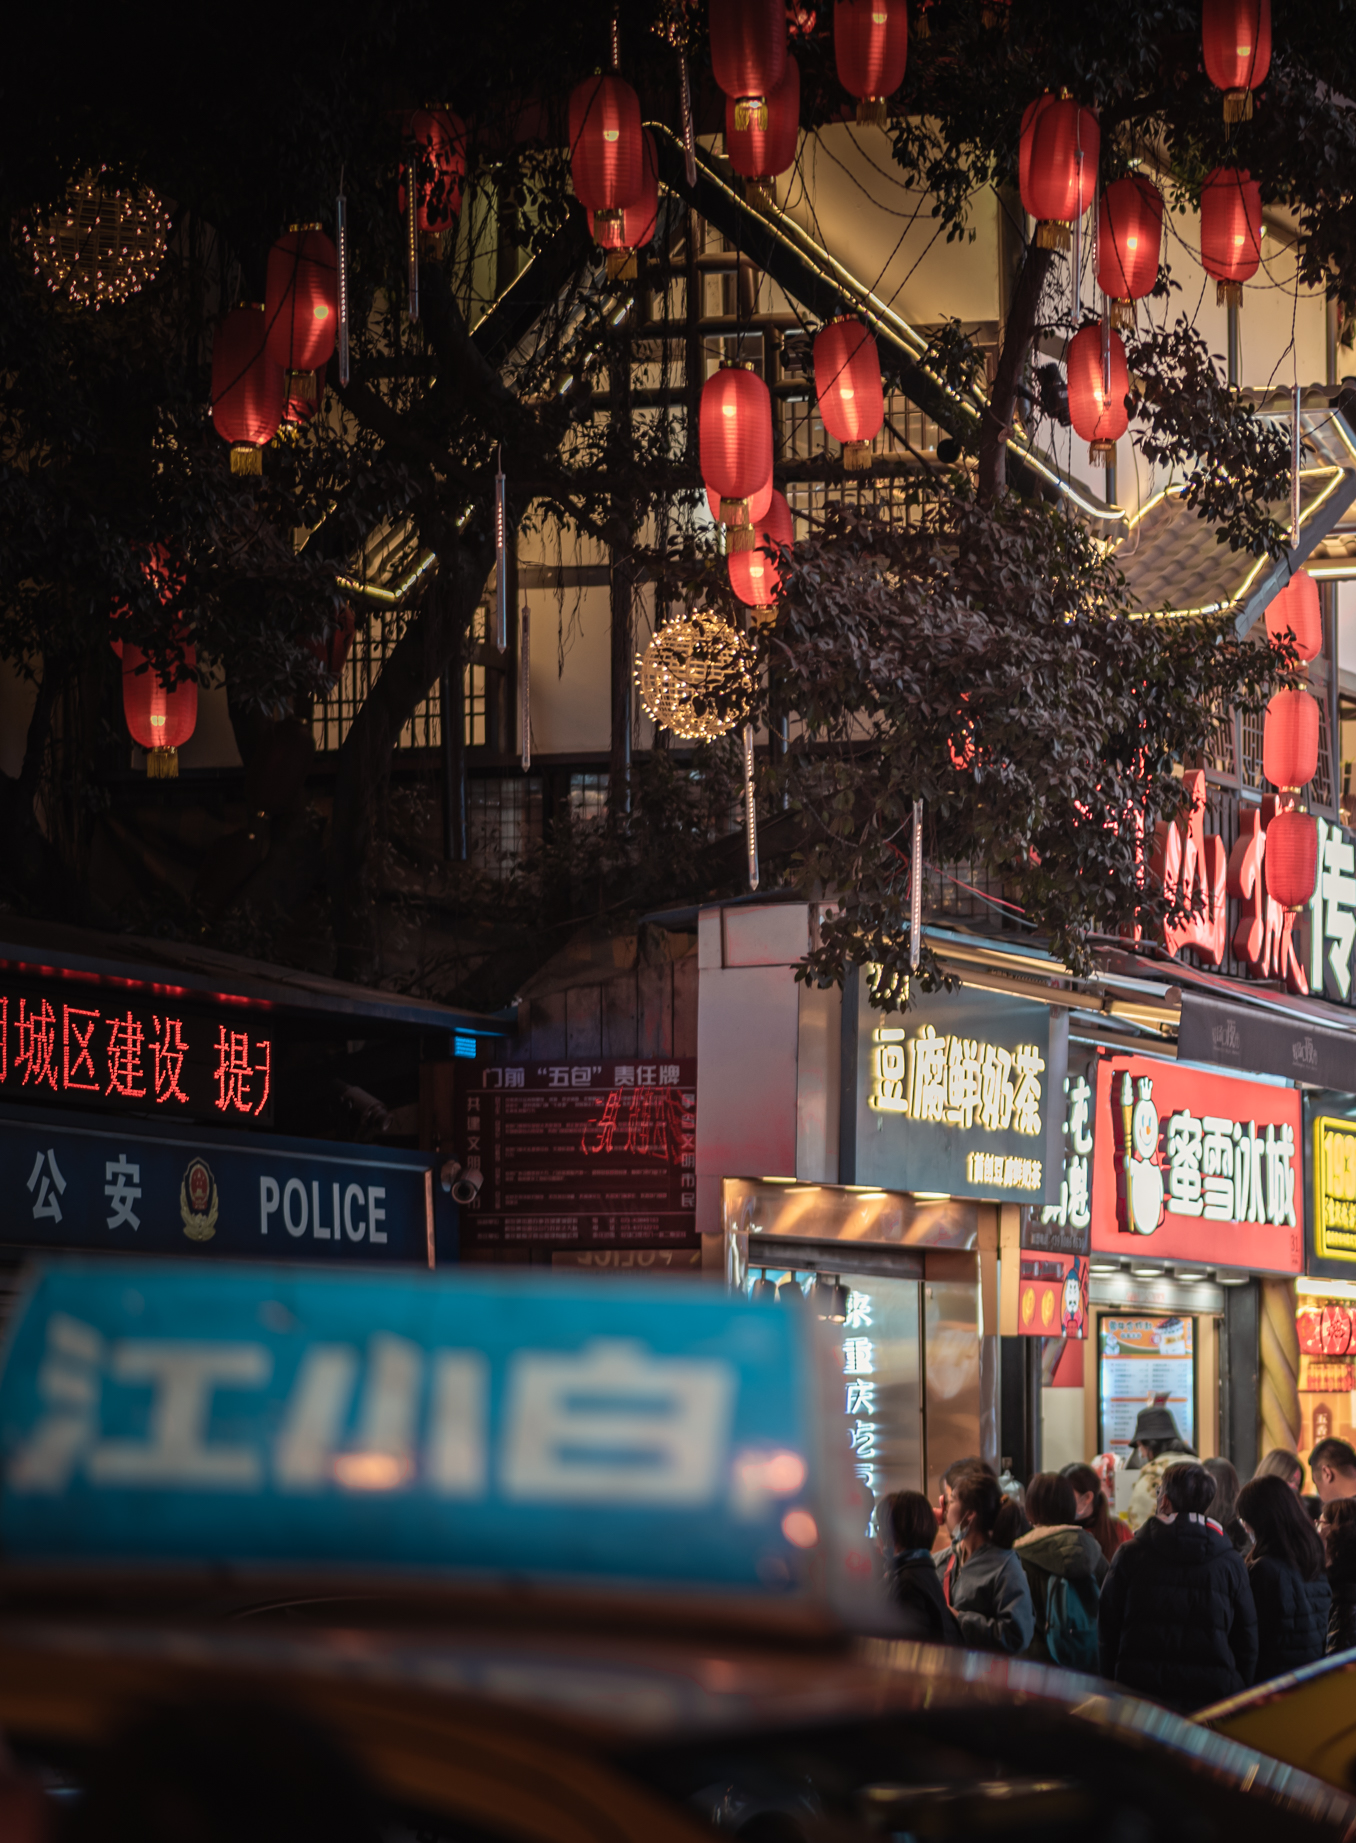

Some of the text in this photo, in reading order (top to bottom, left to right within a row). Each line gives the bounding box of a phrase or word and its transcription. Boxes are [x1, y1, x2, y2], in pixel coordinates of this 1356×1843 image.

[0, 996, 190, 1104] 城区建设
[869, 1024, 1046, 1136] 豆腐鲜奶茶
[27, 1148, 143, 1232] 公安
[467, 1096, 482, 1210] 共建文明市
[1167, 1108, 1297, 1228] 蜜雪冰城
[259, 1175, 389, 1244] POLICE
[4, 1310, 738, 1508] 江小白
